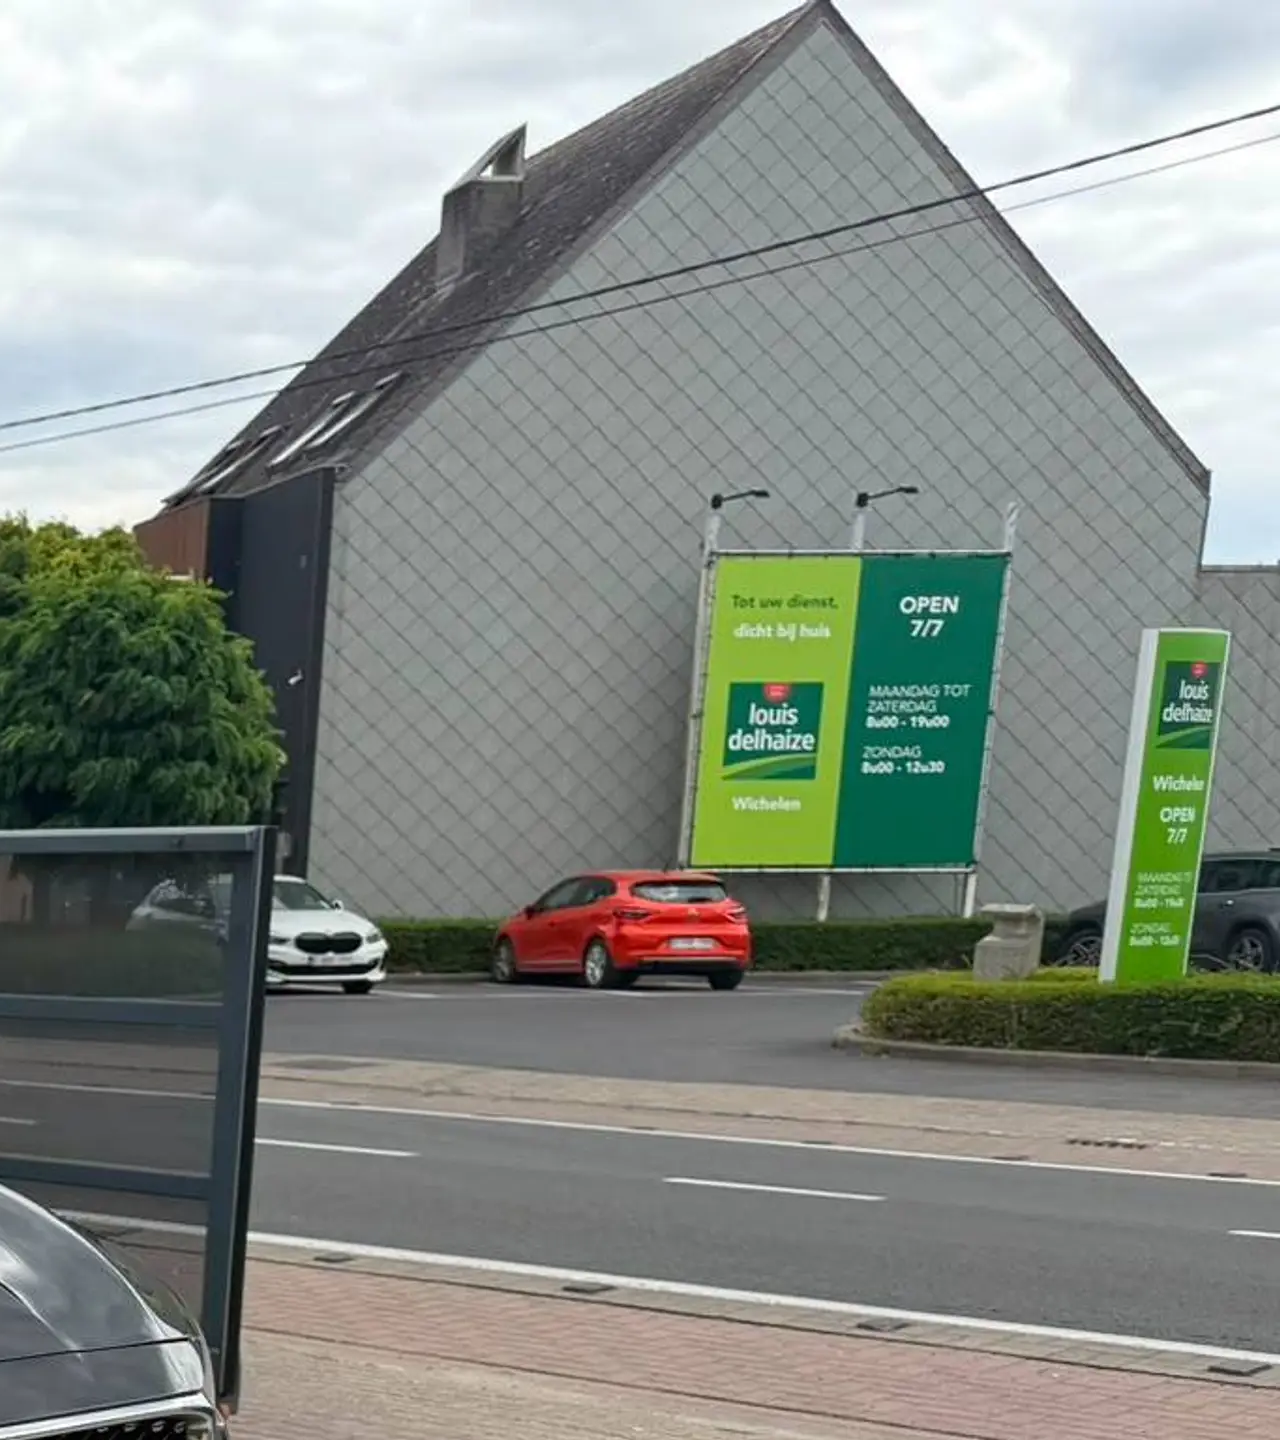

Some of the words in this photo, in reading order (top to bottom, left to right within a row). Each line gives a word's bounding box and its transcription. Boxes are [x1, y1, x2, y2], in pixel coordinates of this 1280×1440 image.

[731, 594, 756, 610] Tot
[759, 597, 782, 609] uw
[899, 595, 960, 615] OPEN
[733, 622, 772, 639] dicht
[776, 622, 797, 642] bij
[799, 622, 831, 639] huis
[910, 618, 945, 638] 7/7
[868, 685, 940, 698] MAANDAG
[942, 684, 972, 697] TOT
[1178, 679, 1210, 700] louis
[748, 703, 799, 726] louis
[867, 700, 938, 713] ZATERDAG
[1162, 702, 1213, 724] delhaize
[728, 729, 815, 751] delhaize
[862, 746, 922, 759] ZONDAG
[732, 796, 802, 812] Wichelen
[1159, 806, 1196, 823] OPEN
[1166, 827, 1189, 844] 7/7
